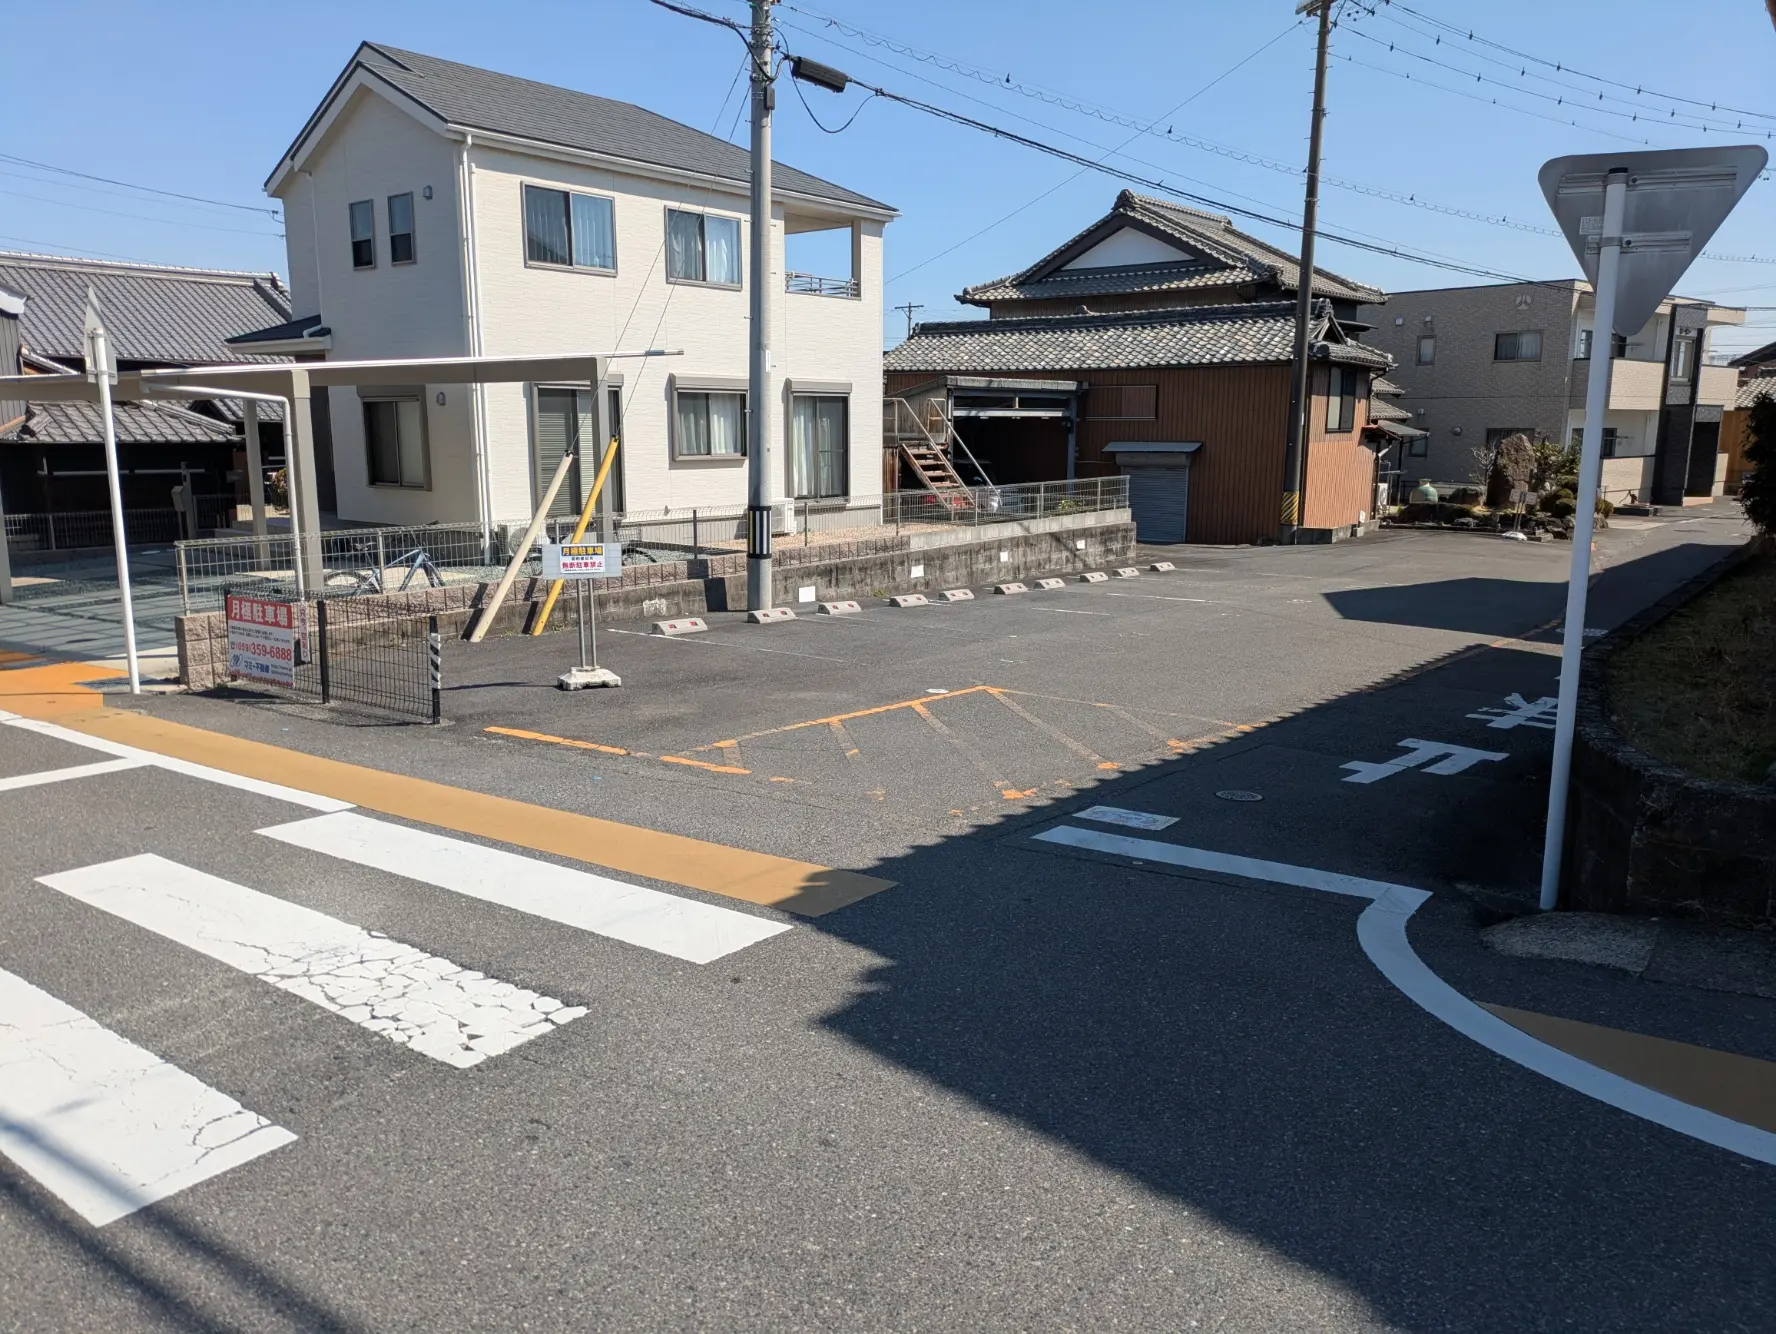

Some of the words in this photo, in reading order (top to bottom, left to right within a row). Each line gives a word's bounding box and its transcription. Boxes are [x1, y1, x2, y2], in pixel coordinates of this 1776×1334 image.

[563, 546, 602, 555] 月極駐車場
[562, 561, 603, 569] 無断駐車禁止
[231, 600, 288, 627] 月極駐車場
